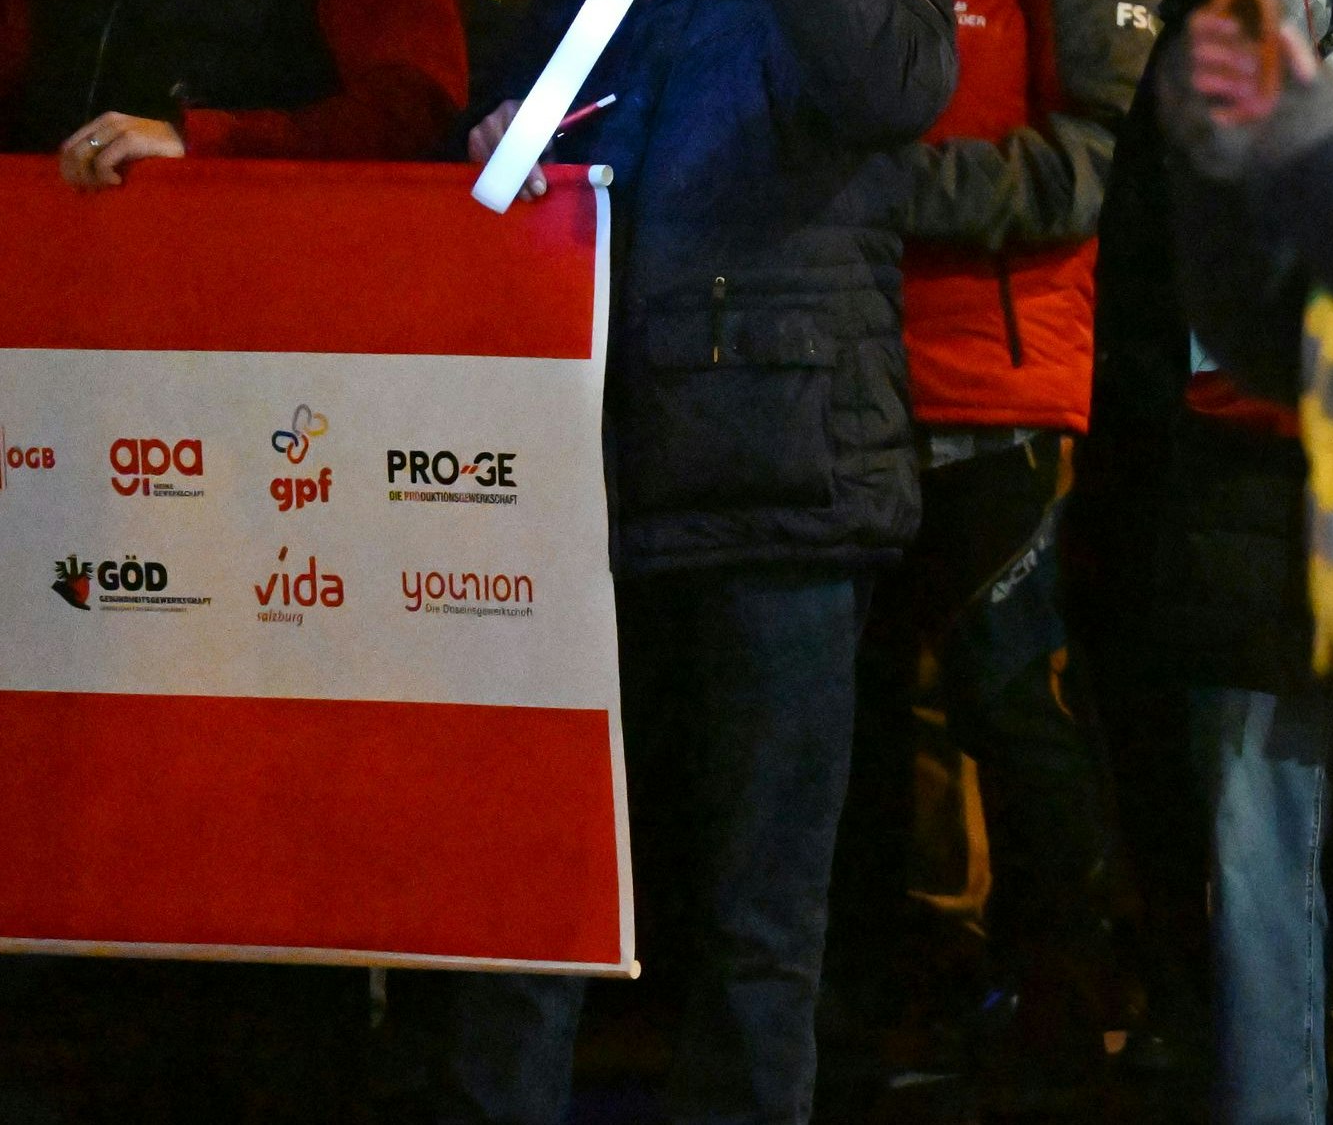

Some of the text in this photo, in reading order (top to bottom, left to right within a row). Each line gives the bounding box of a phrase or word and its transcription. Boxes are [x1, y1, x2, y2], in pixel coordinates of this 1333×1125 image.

[269, 467, 333, 512] gpf
[389, 490, 518, 505] DIE PRODUKTIONSGEWERKSCHAFT
[97, 554, 168, 592] GÖD
[254, 546, 345, 608] vida
[402, 571, 534, 613] younion
[257, 610, 304, 626] salzburg
[425, 603, 441, 613] Die
